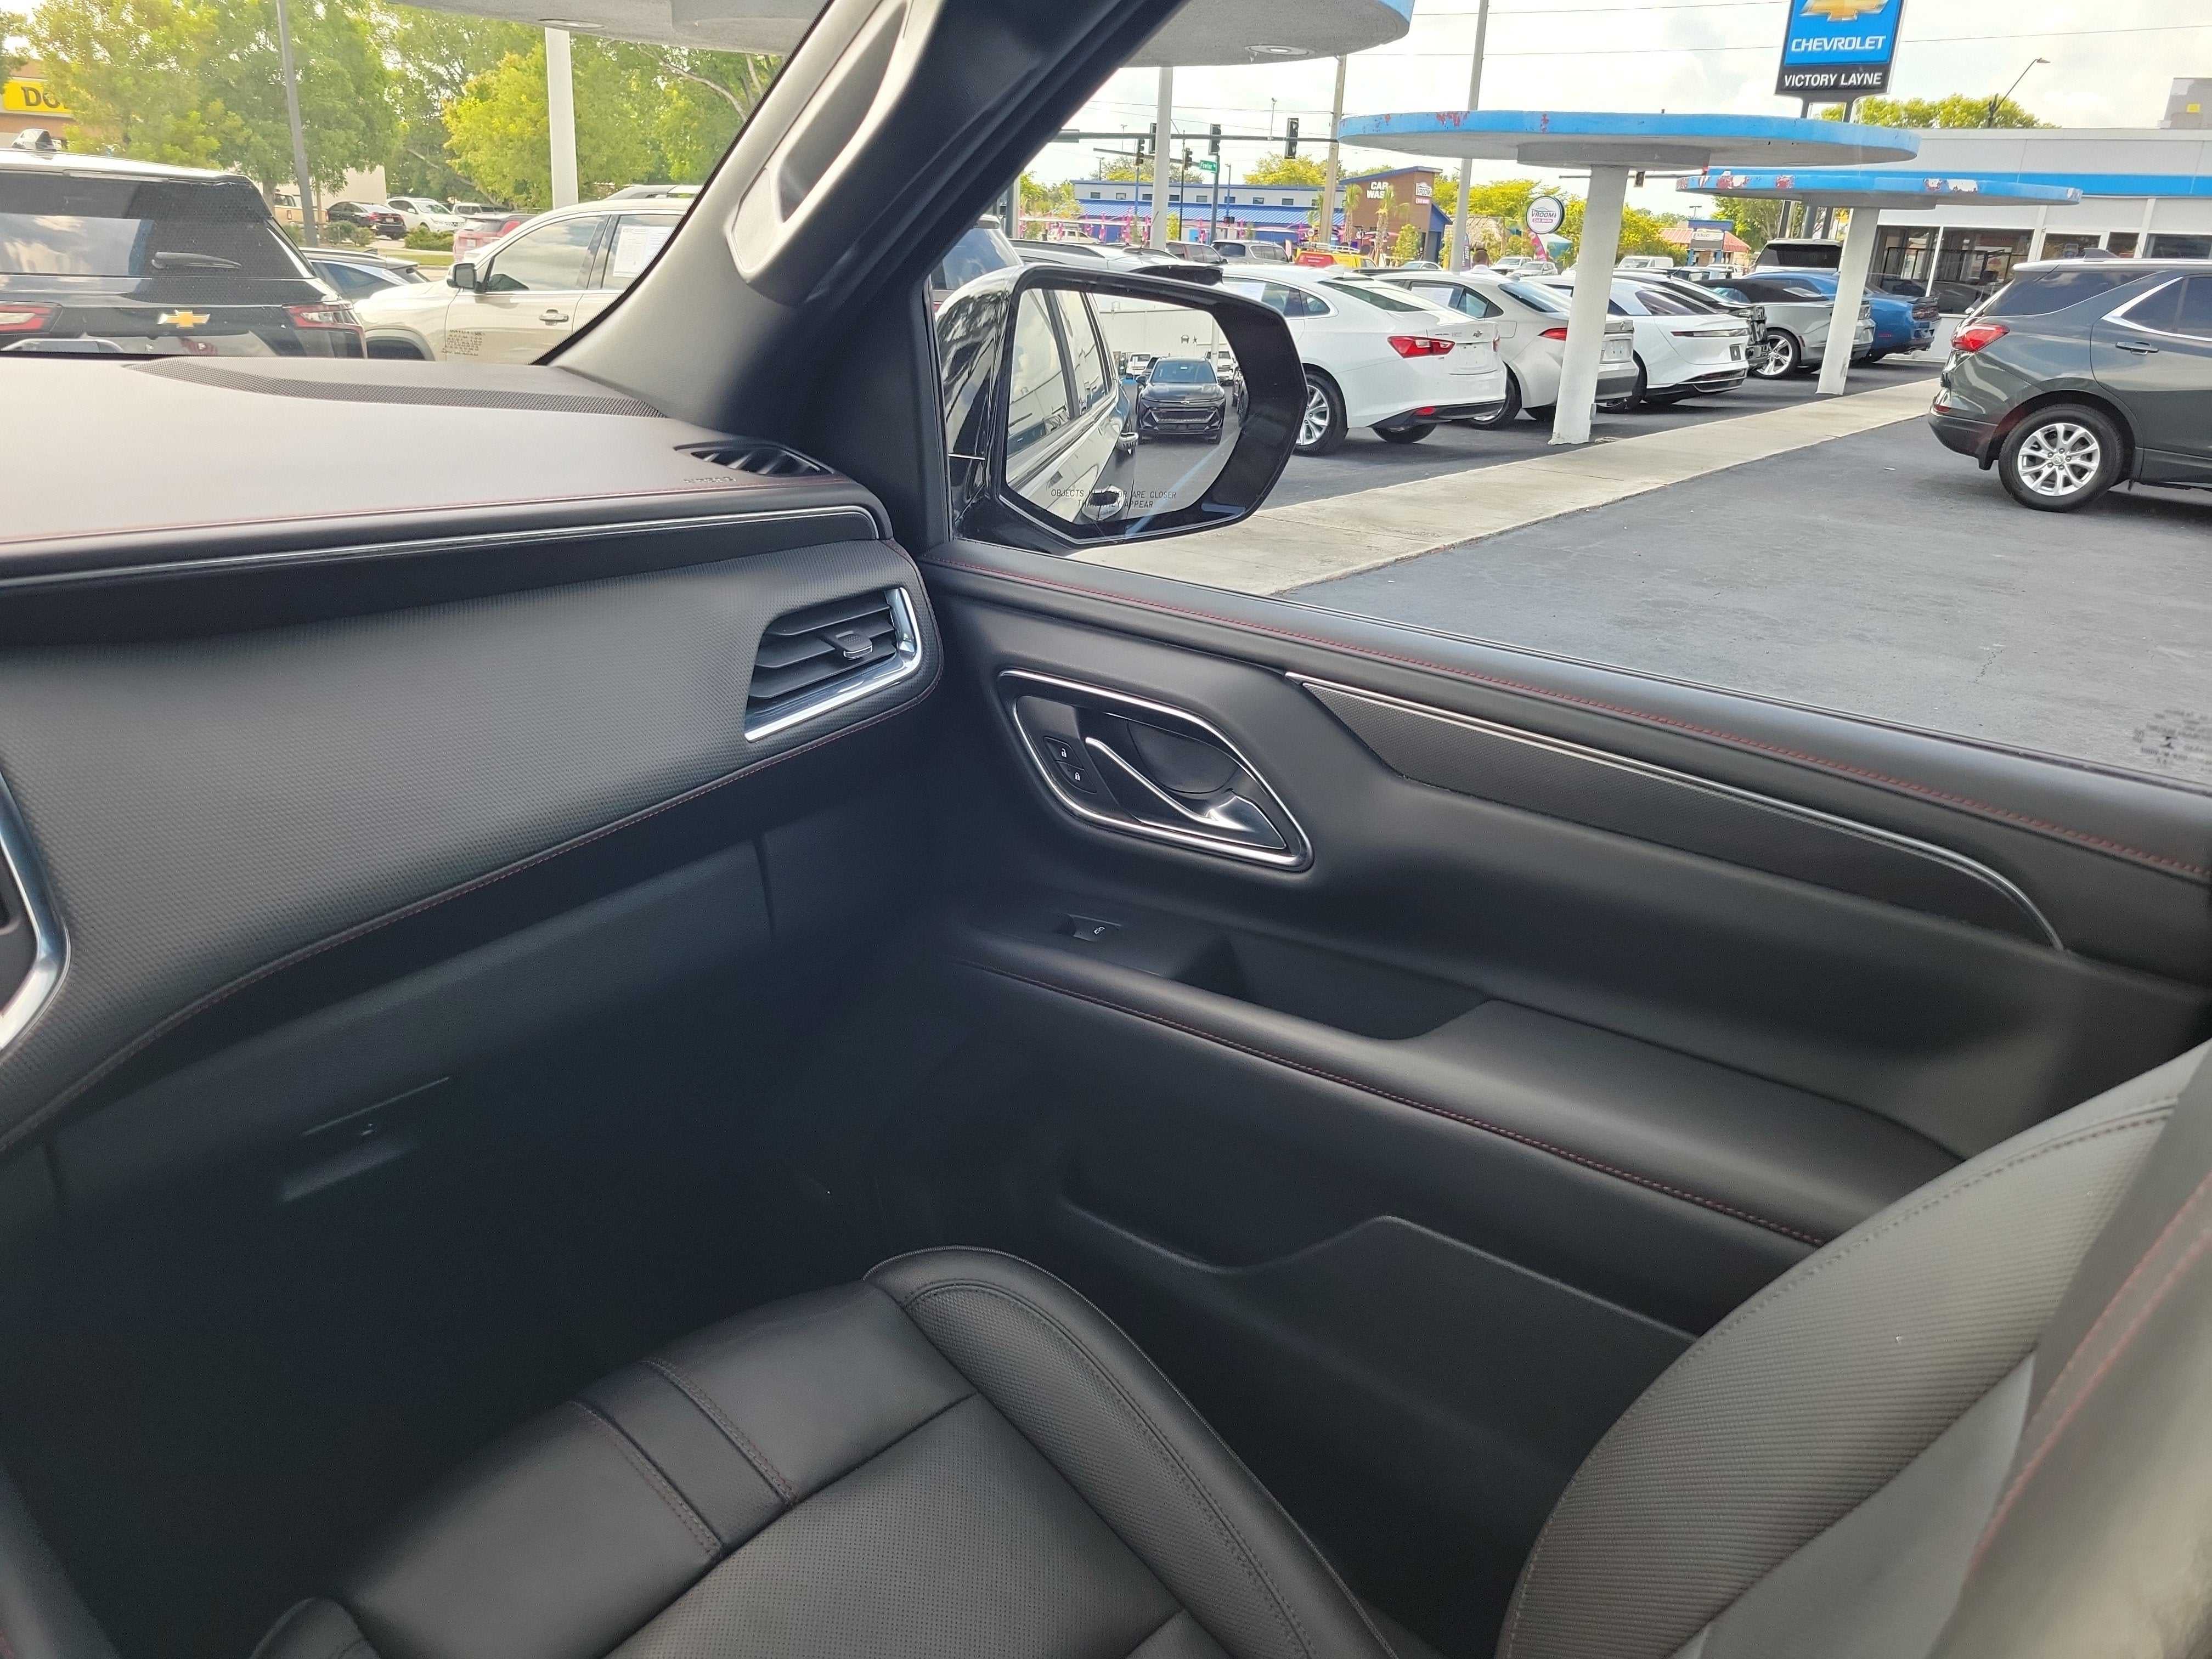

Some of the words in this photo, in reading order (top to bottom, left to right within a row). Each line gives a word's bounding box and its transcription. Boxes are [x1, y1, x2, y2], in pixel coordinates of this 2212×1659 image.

[1791, 35, 1887, 52] CHEVROLET
[1784, 74, 1838, 87] VICTORY
[1841, 72, 1883, 86] LAYNE
[1366, 190, 1394, 199] WAS
[1531, 208, 1554, 218] VROOM
